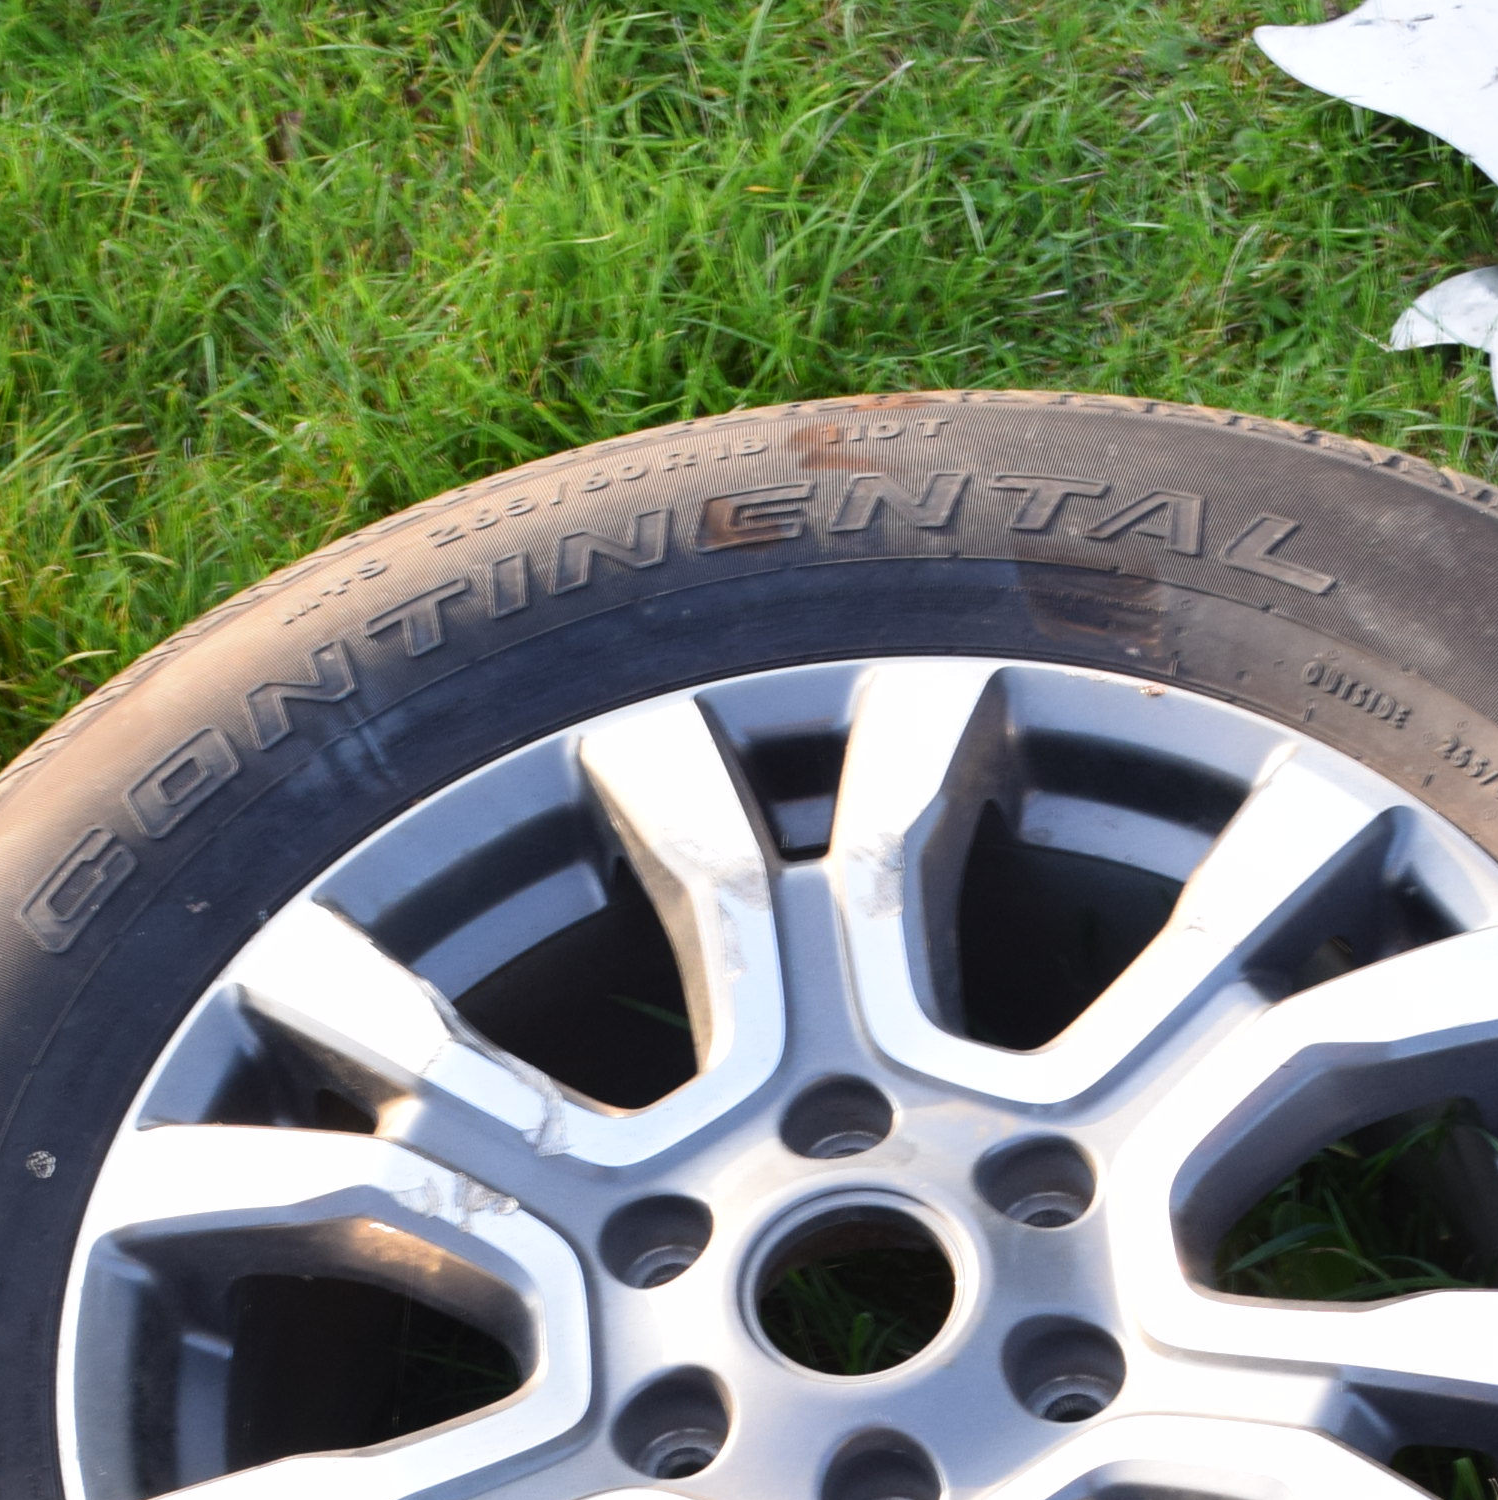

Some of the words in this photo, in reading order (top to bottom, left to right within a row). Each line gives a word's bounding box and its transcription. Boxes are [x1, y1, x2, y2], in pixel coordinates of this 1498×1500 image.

[284, 558, 389, 625] M+S
[17, 470, 1337, 954] CONTINENTAL
[1303, 660, 1414, 730] OUTSIDE
